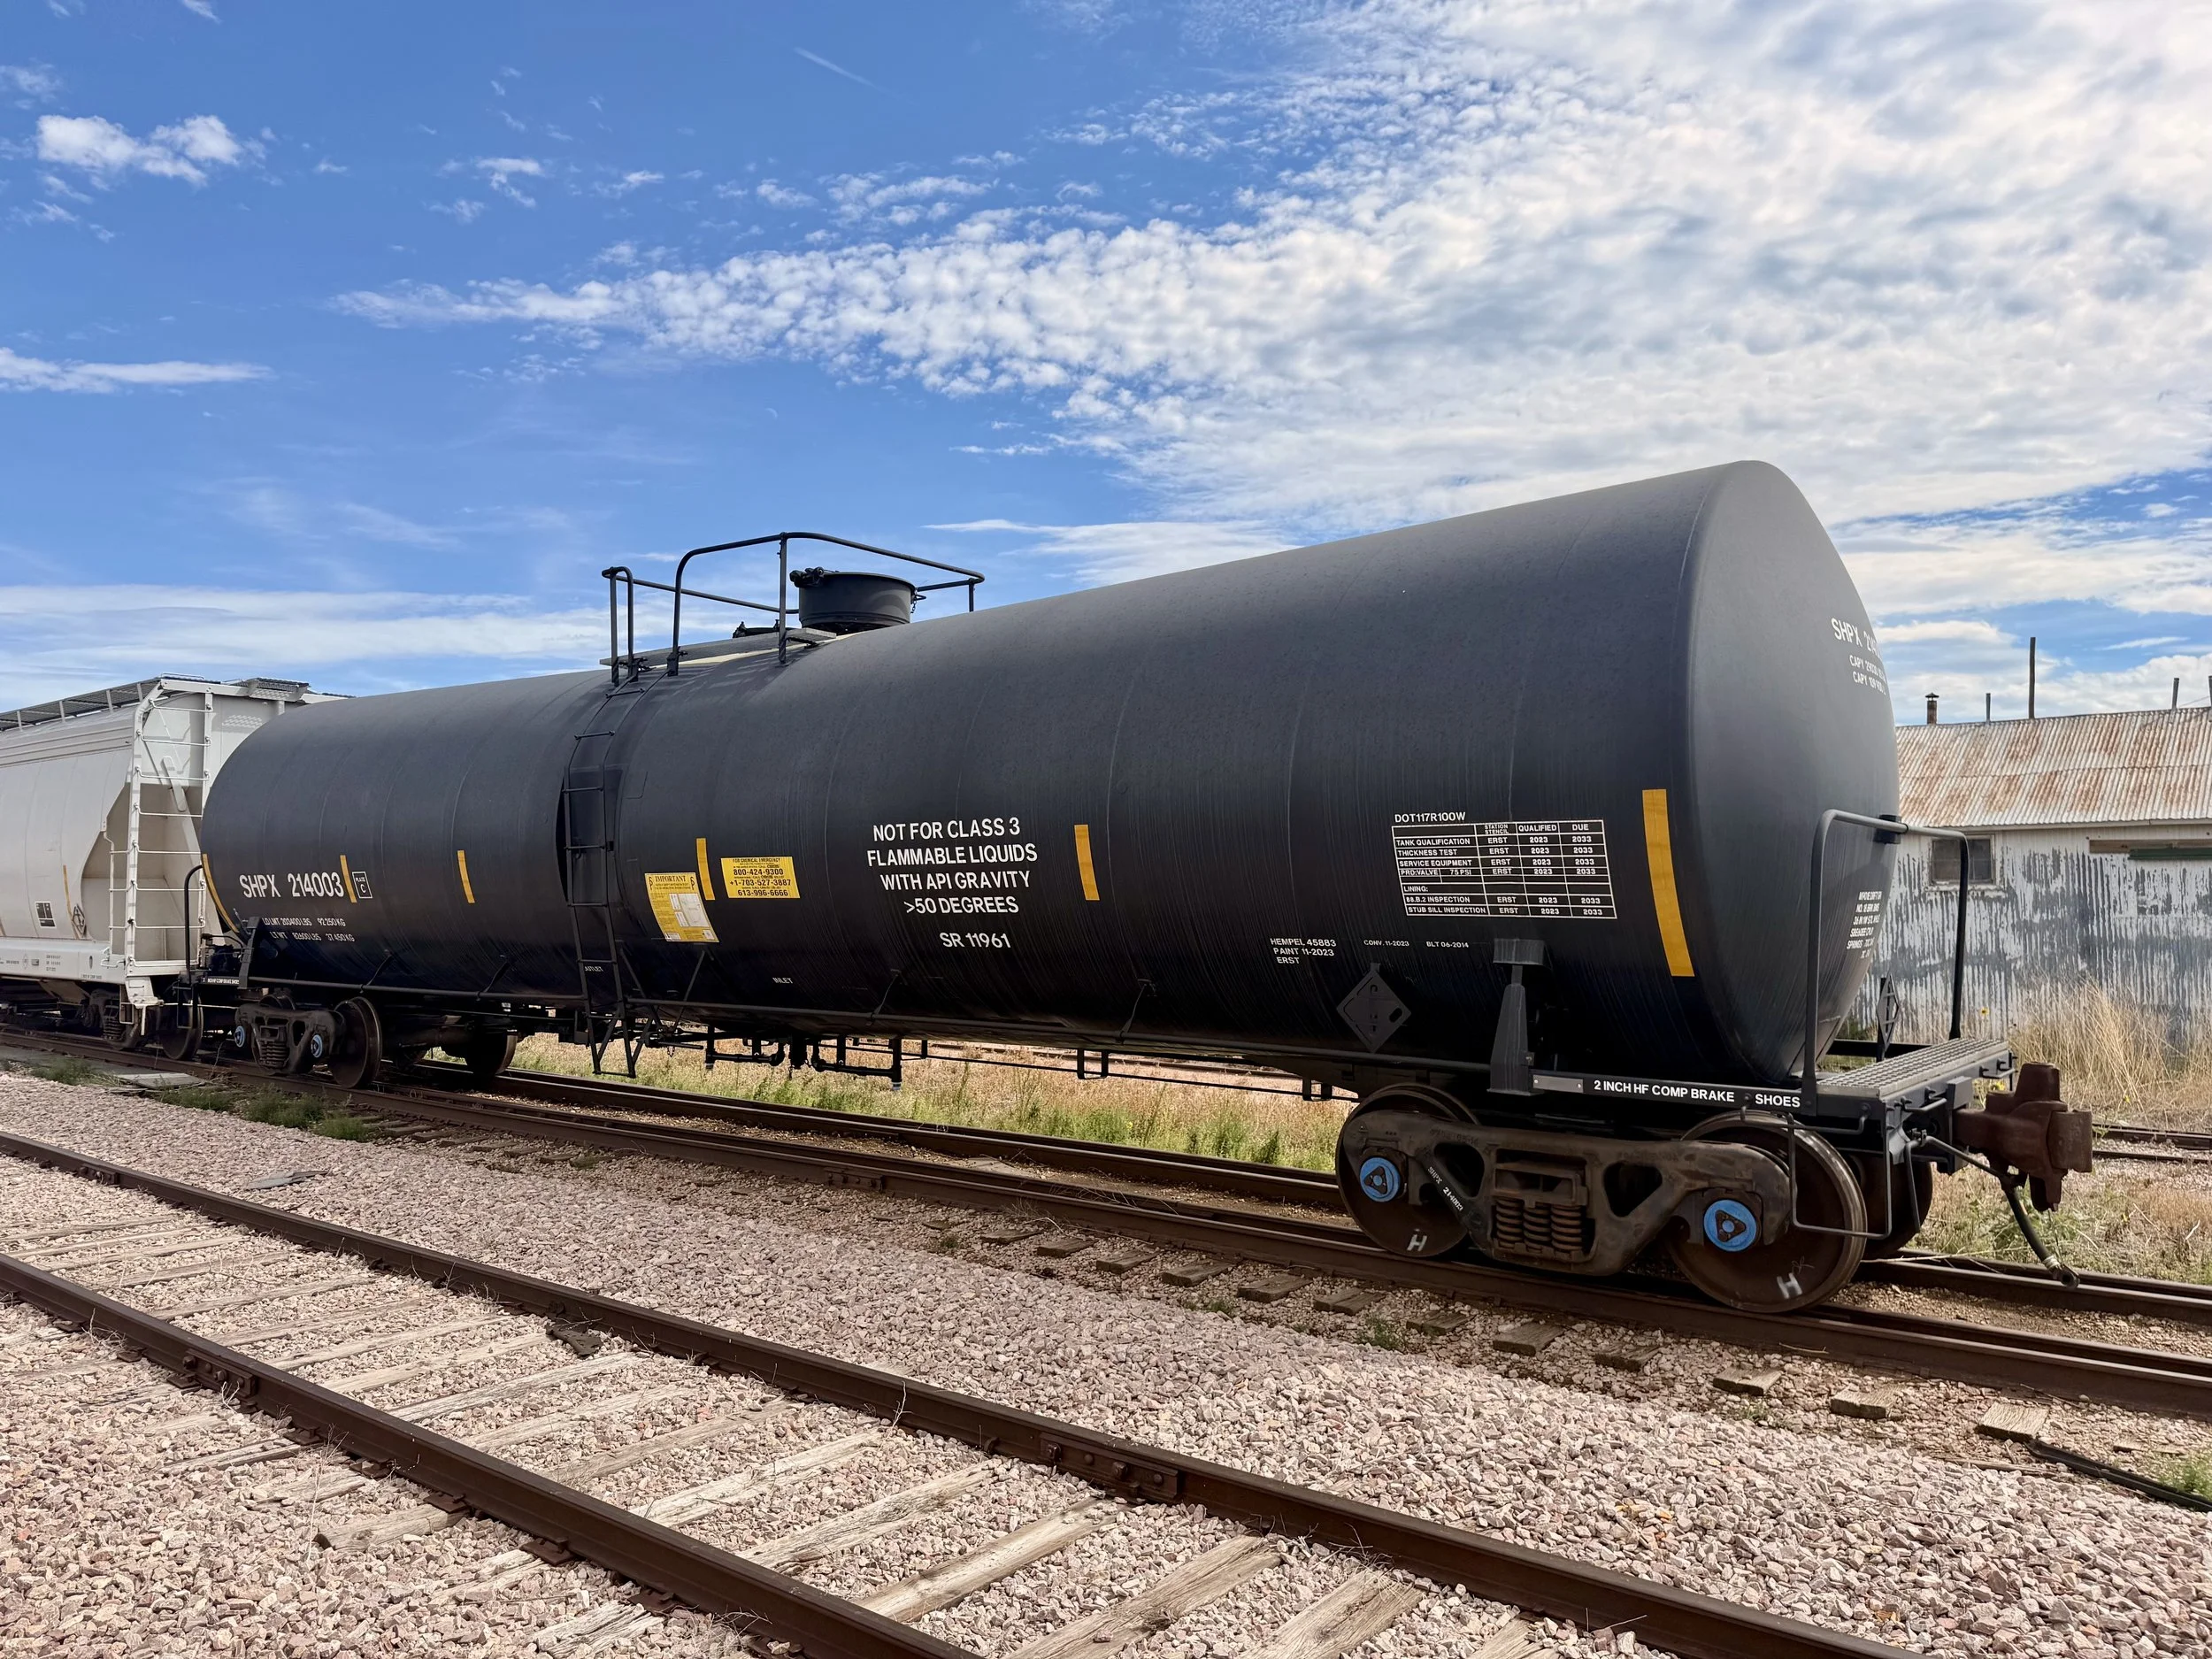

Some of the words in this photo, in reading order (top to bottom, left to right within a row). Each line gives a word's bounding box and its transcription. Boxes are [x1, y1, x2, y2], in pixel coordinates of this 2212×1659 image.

[1831, 618, 1863, 648] SHPX
[1394, 811, 1466, 823] DOT117R100W
[872, 824, 906, 841] NOT
[910, 821, 943, 841] FOR
[947, 818, 1005, 839] CLASS
[1009, 817, 1020, 835] 3
[867, 846, 967, 867] FLAMMABLE
[968, 843, 1038, 864] LIQUIDS
[239, 874, 281, 898] SHPX
[288, 872, 344, 897] 214003
[360, 884, 366, 894] C
[880, 873, 923, 890] WITH
[926, 872, 952, 890] API
[954, 870, 1031, 889] GRAVITY
[903, 897, 937, 914] >50
[938, 895, 1019, 914] DEGREES
[336, 918, 346, 927] KG
[939, 932, 964, 948] SR
[965, 932, 1011, 949] 11961
[1270, 938, 1305, 947] HEMPEL
[1306, 939, 1337, 948] 45883
[1301, 948, 1334, 956] 11-2023
[1594, 1079, 1601, 1090] 2
[1603, 1080, 1632, 1093] INCH
[1633, 1083, 1649, 1094] HF
[1651, 1085, 1688, 1098] COMP
[1690, 1089, 1735, 1102] BRAKE
[1755, 1093, 1801, 1108] SHOES
[1427, 1166, 1442, 1185] SHPX
[1442, 1187, 1463, 1211] 214003
[1407, 1233, 1427, 1252] H
[1776, 1272, 1802, 1299] H
